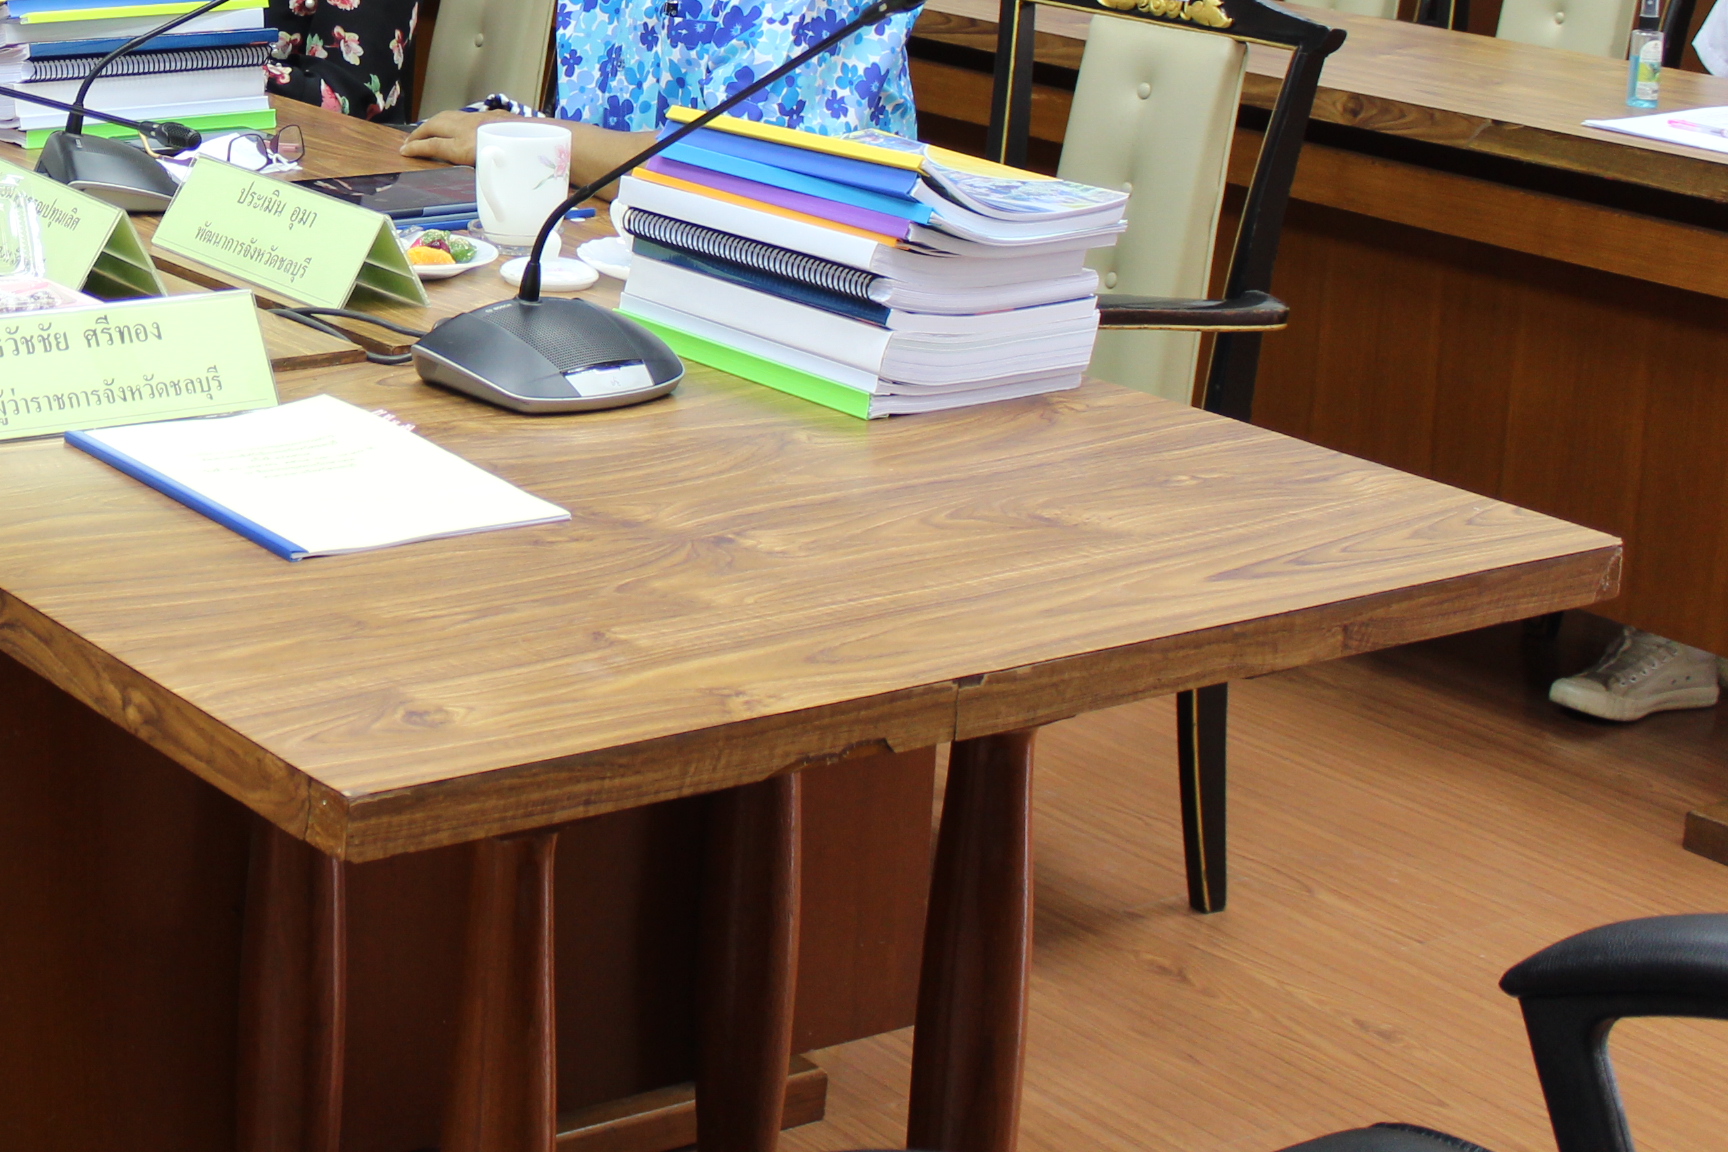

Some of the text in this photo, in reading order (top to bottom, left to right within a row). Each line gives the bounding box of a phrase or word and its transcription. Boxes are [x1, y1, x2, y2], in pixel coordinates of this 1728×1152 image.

[237, 180, 318, 231] ประเมิน อุมา
[195, 220, 312, 283] พัฒนาการจังหวัดชลบุรี
[83, 314, 164, 348] ศรีทอง
